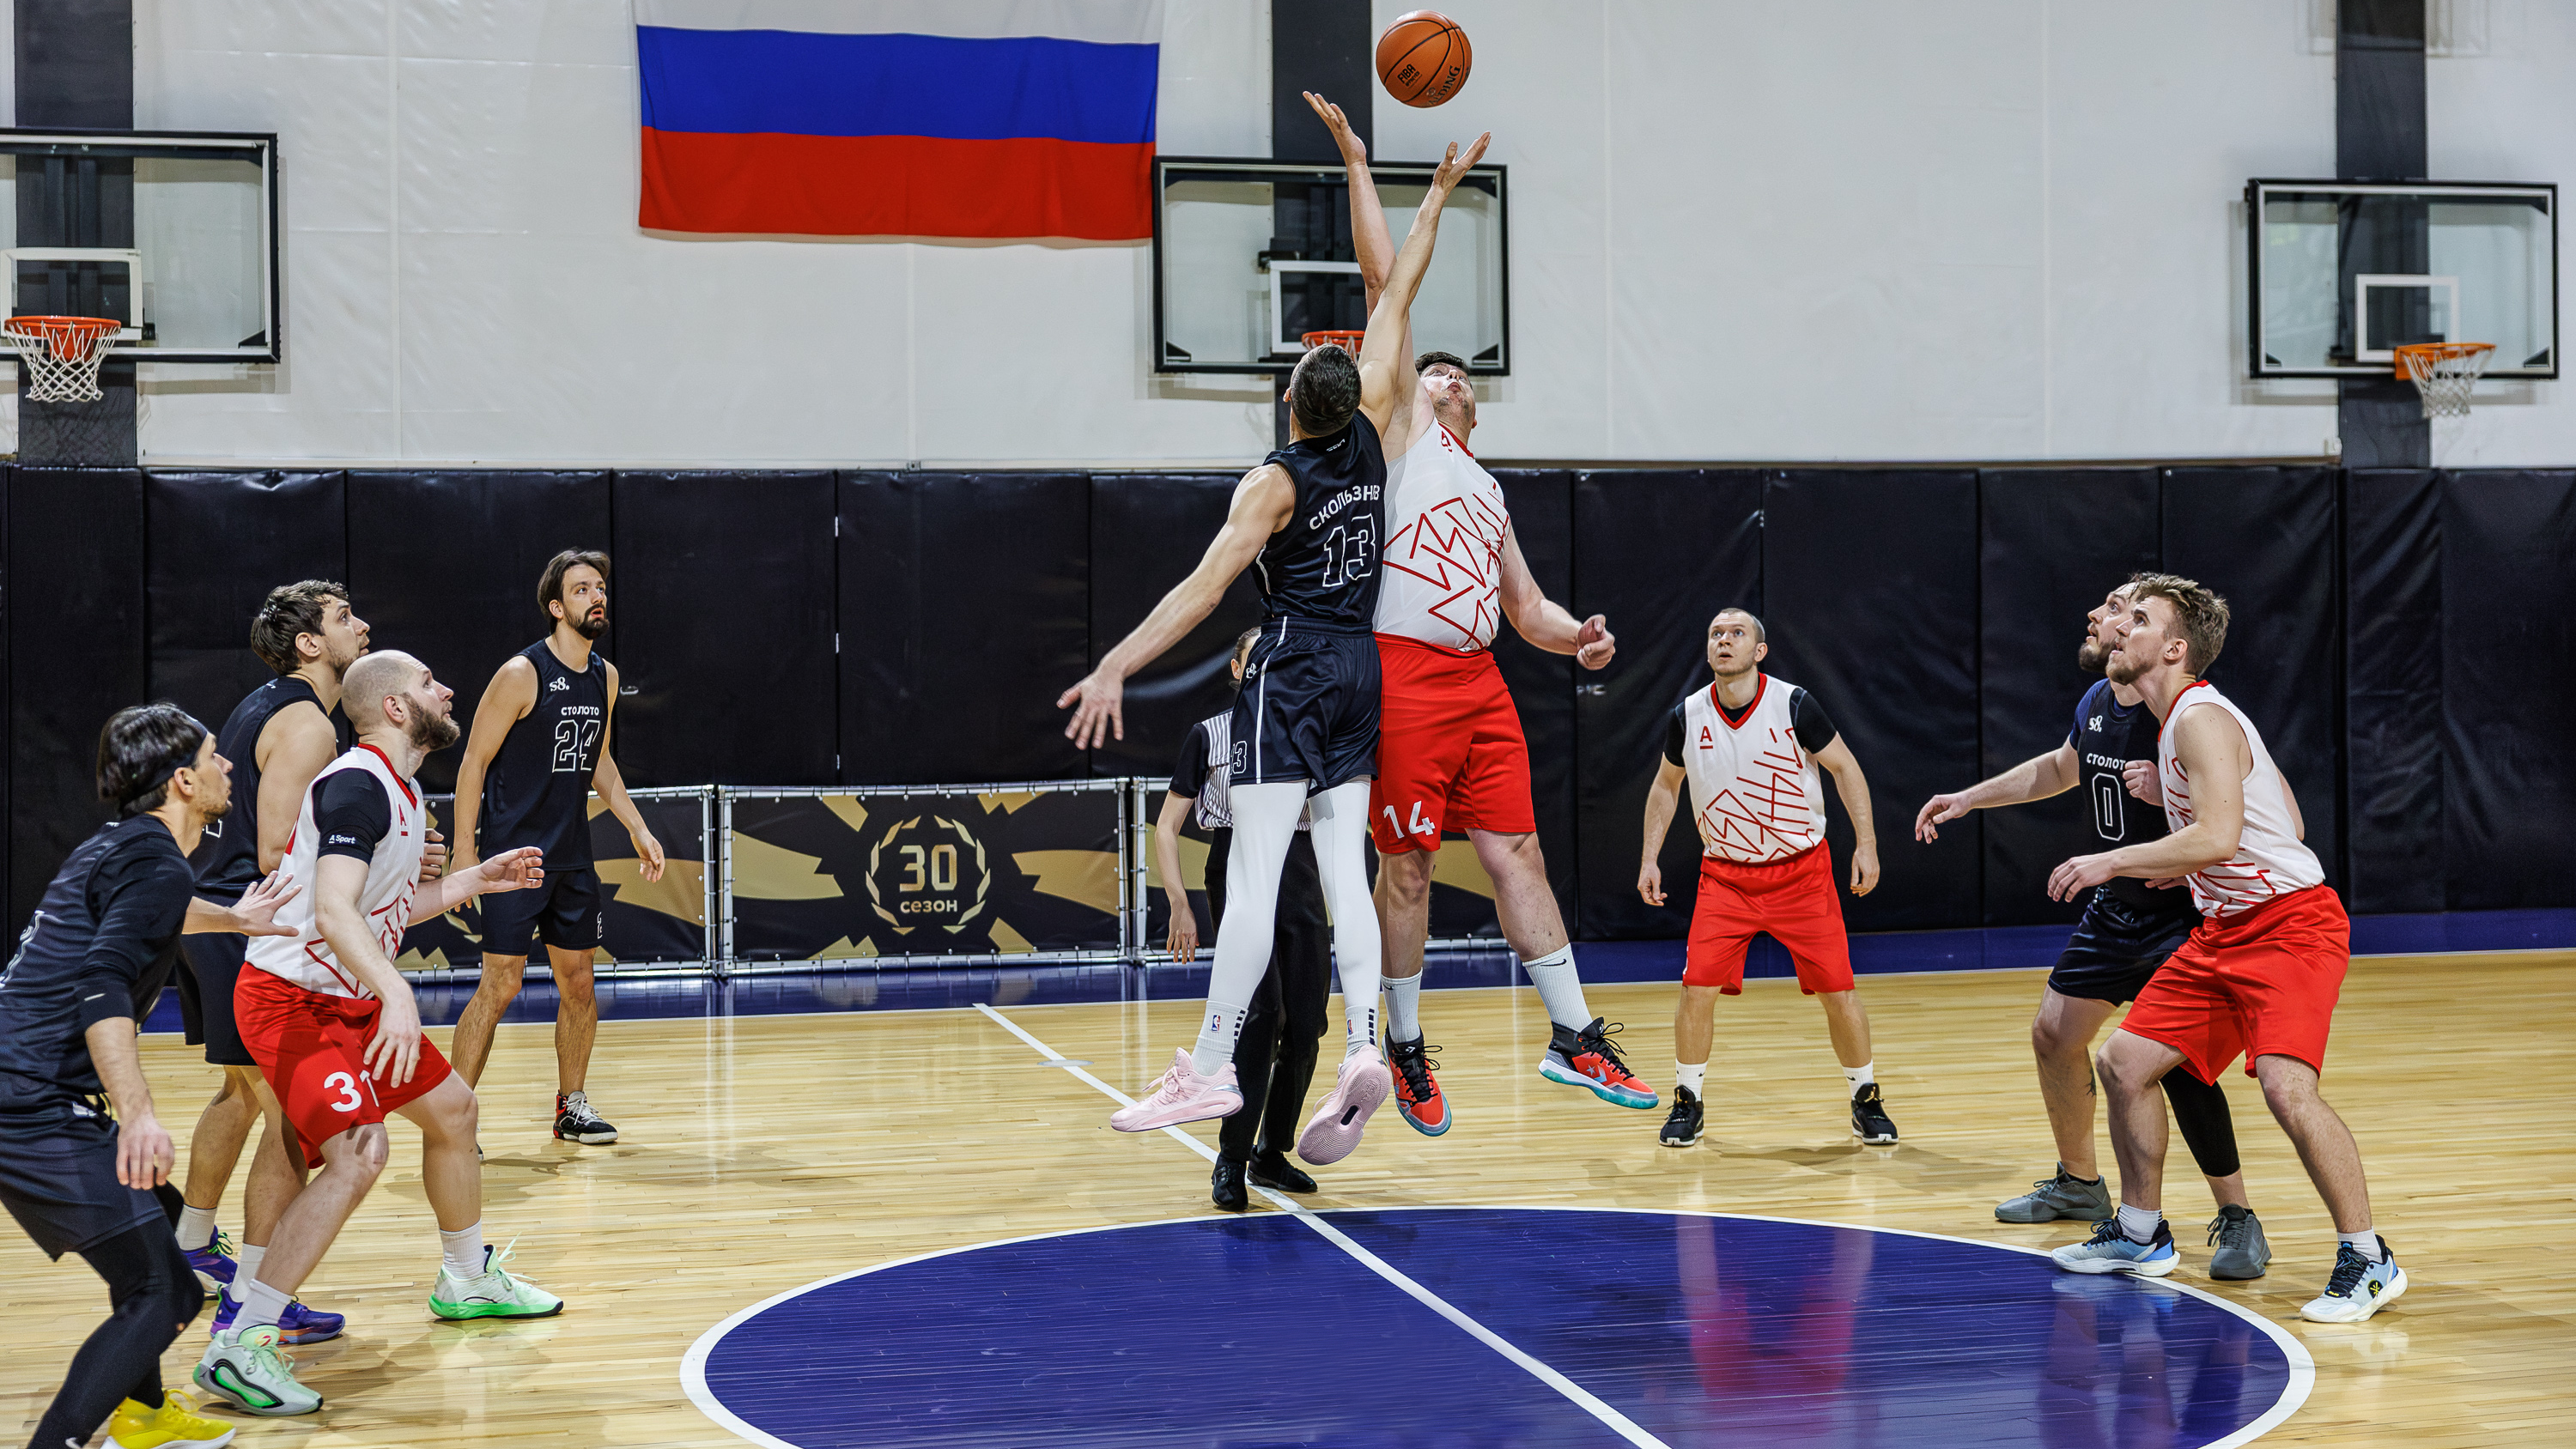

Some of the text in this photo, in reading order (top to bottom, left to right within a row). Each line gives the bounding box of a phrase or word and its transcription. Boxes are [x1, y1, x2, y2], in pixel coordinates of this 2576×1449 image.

[1397, 64, 1416, 83] FIBA
[1428, 65, 1461, 106] ALDING
[1322, 512, 1376, 587] 13
[552, 719, 600, 773] 24
[2087, 752, 2127, 771] СТОЛОТ
[1383, 801, 1435, 839] 14
[2093, 773, 2124, 841] 0
[336, 834, 355, 844] Sport
[899, 844, 957, 892] 30
[900, 900, 958, 913] сезон
